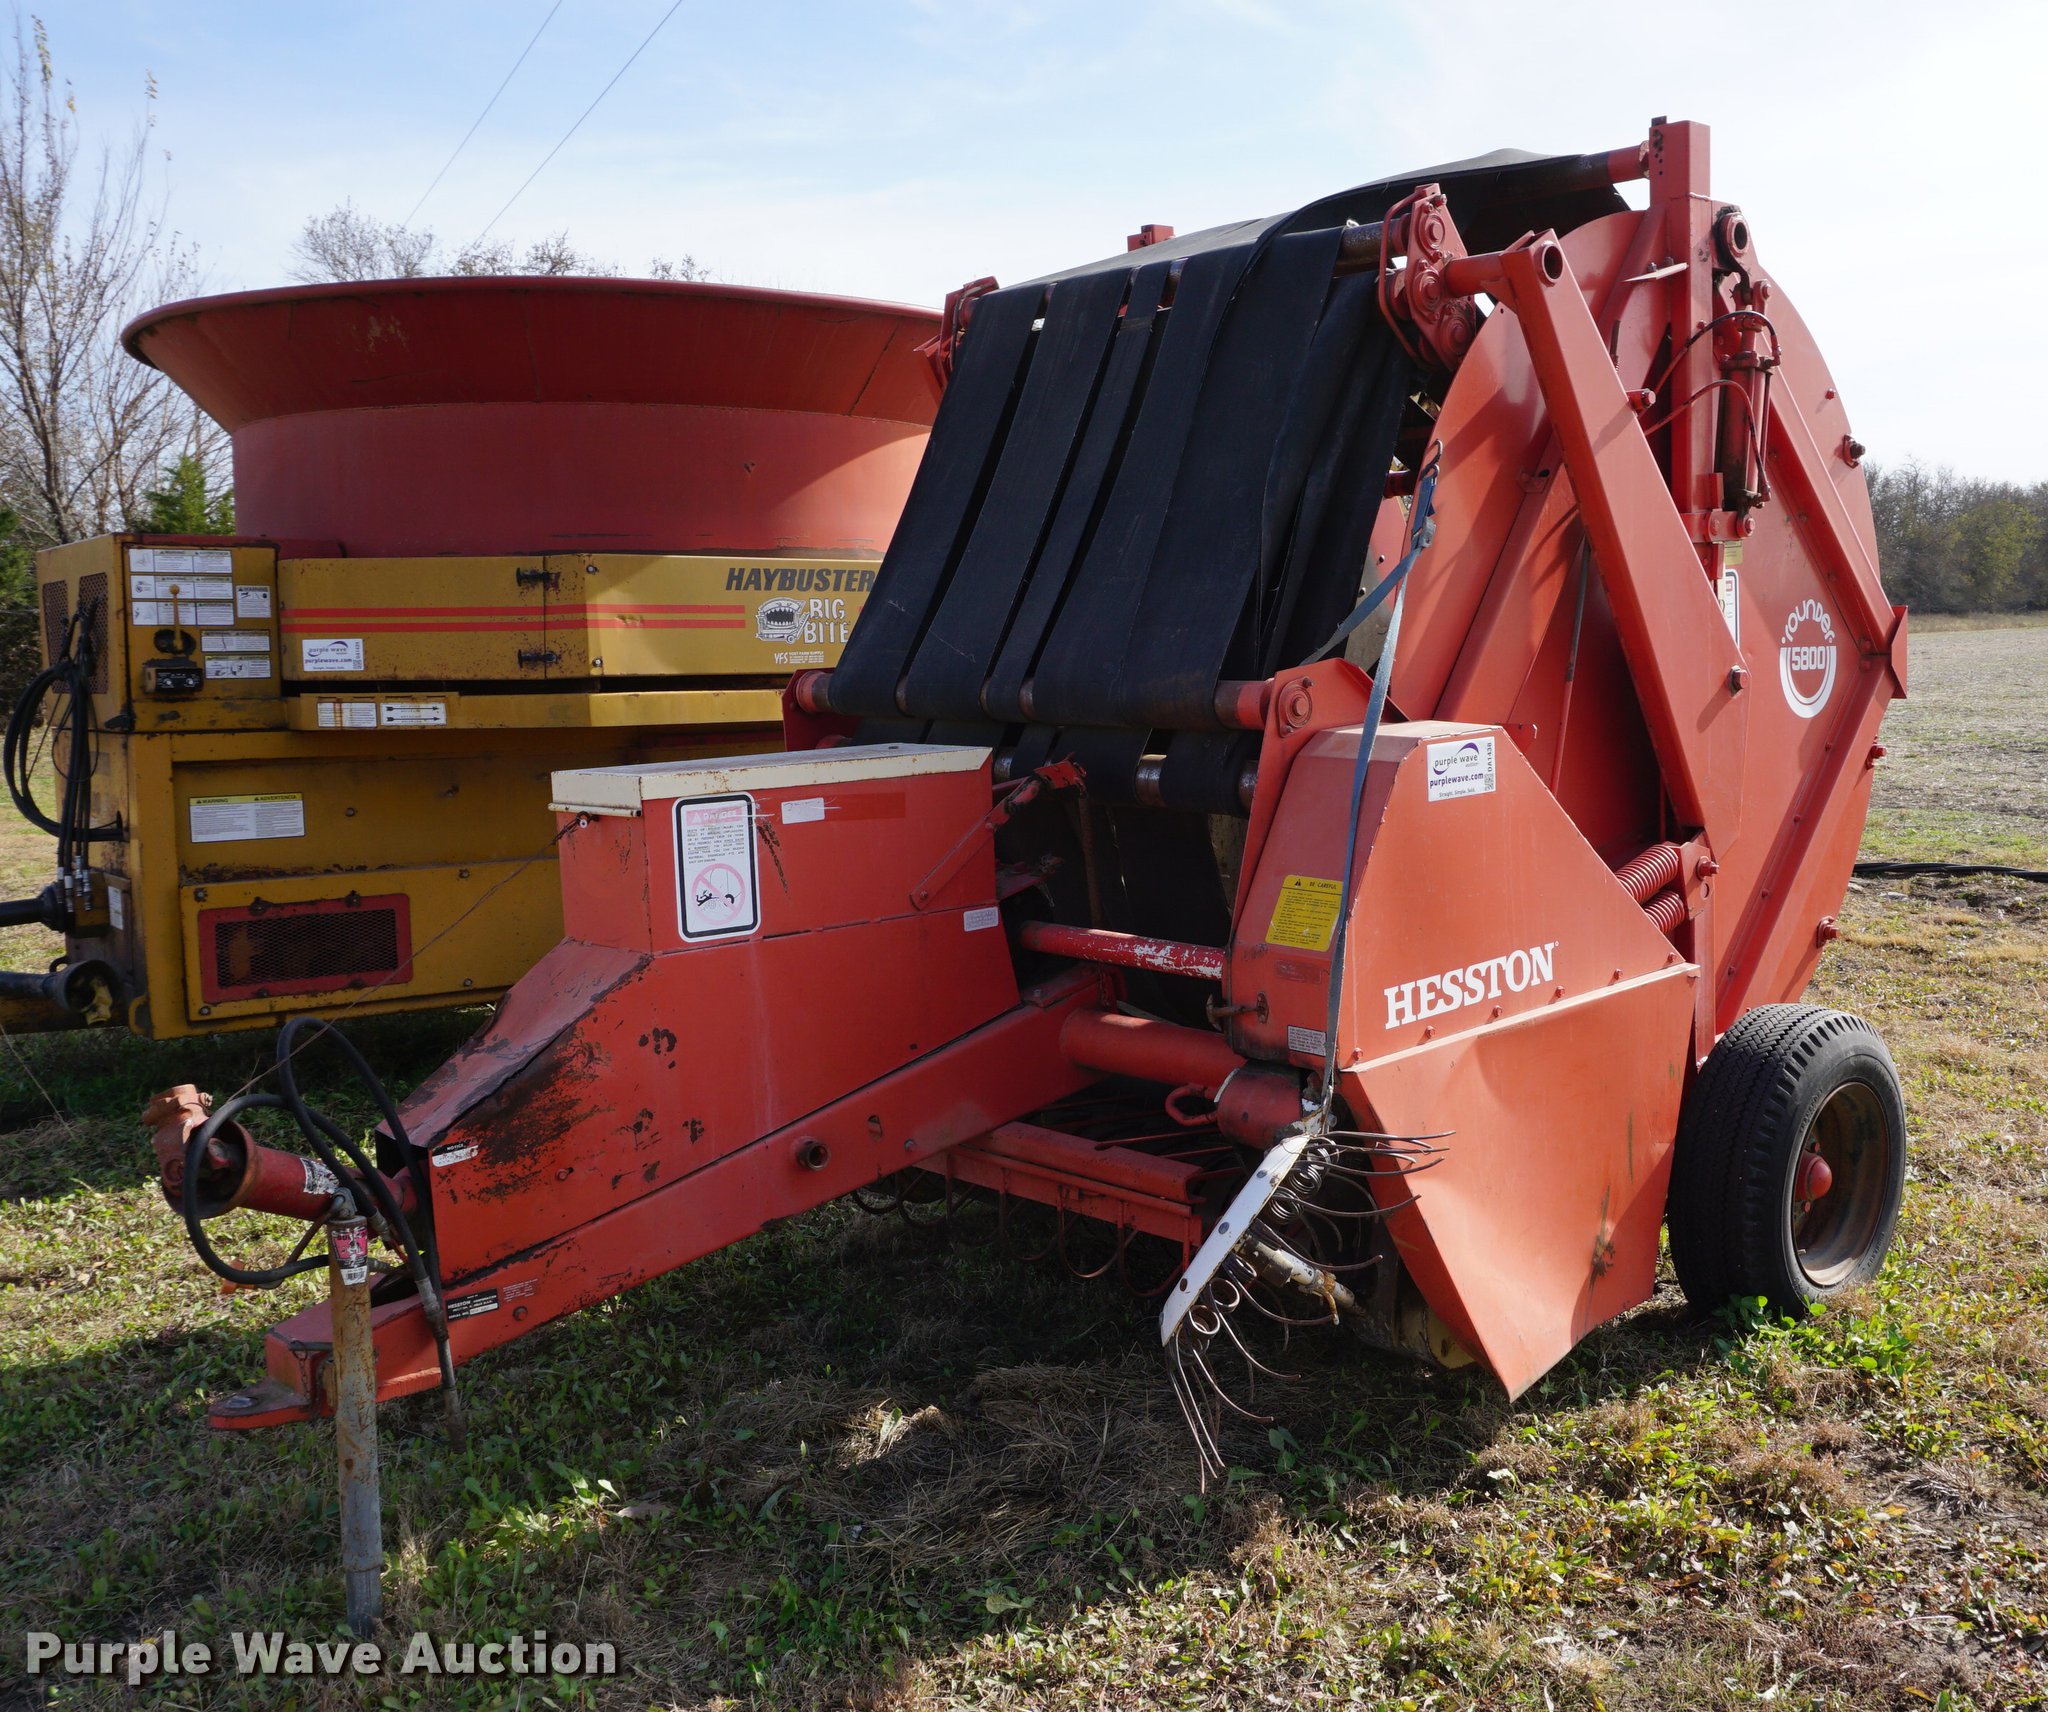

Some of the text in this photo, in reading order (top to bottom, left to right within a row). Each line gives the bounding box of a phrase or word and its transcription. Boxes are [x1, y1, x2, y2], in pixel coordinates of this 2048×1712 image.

[725, 567, 875, 592] HAYBUSTER
[808, 598, 845, 620] BIG
[803, 621, 850, 644] BITE
[1791, 646, 1826, 671] 5800
[1434, 754, 1478, 768] purple wave
[1429, 773, 1484, 789] purplewave.com
[1317, 882, 1337, 890] CAREFUL
[1383, 941, 1555, 1030] HESSTON
